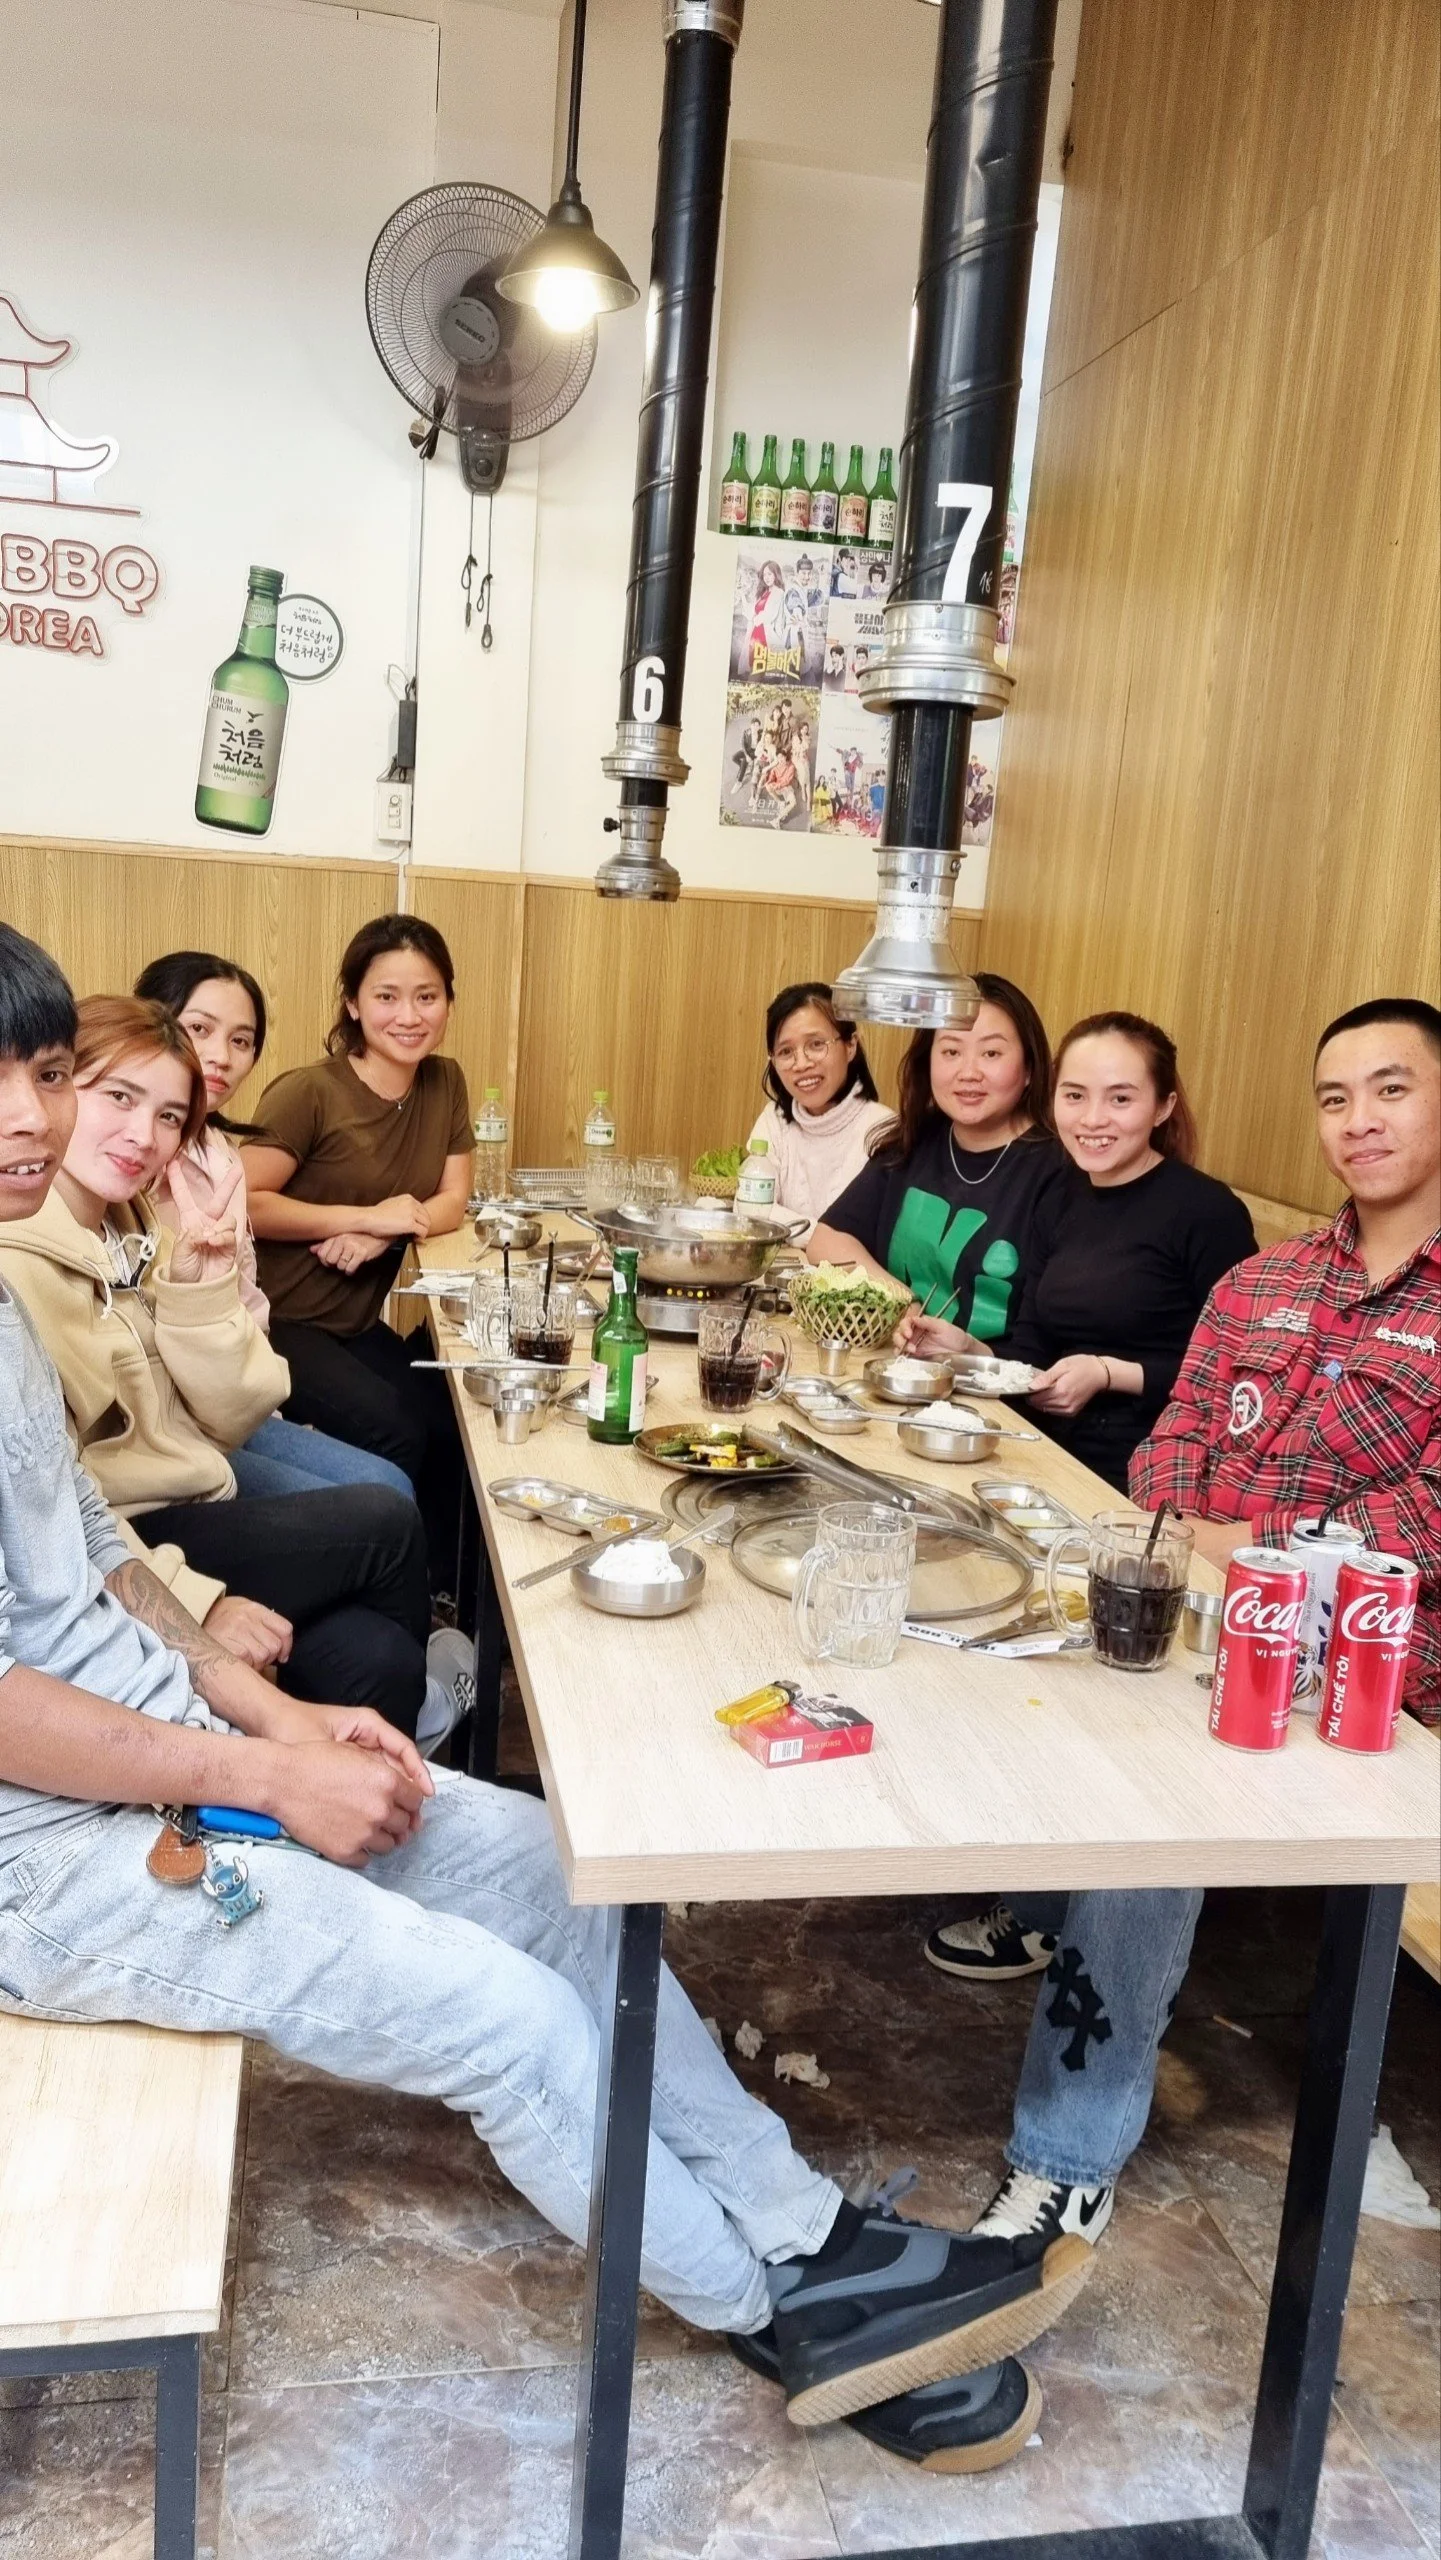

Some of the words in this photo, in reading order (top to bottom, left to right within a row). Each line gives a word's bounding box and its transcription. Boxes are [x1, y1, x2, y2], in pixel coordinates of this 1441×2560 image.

[937, 483, 993, 604] 7
[1, 533, 159, 615] BBQ
[632, 656, 666, 723] 6
[222, 720, 266, 749] 처음
[218, 743, 264, 769] 처럼
[1336, 1655, 1350, 1680] TÔI
[1332, 1678, 1346, 1713] CHẾ
[1328, 1712, 1341, 1739] TÁI
